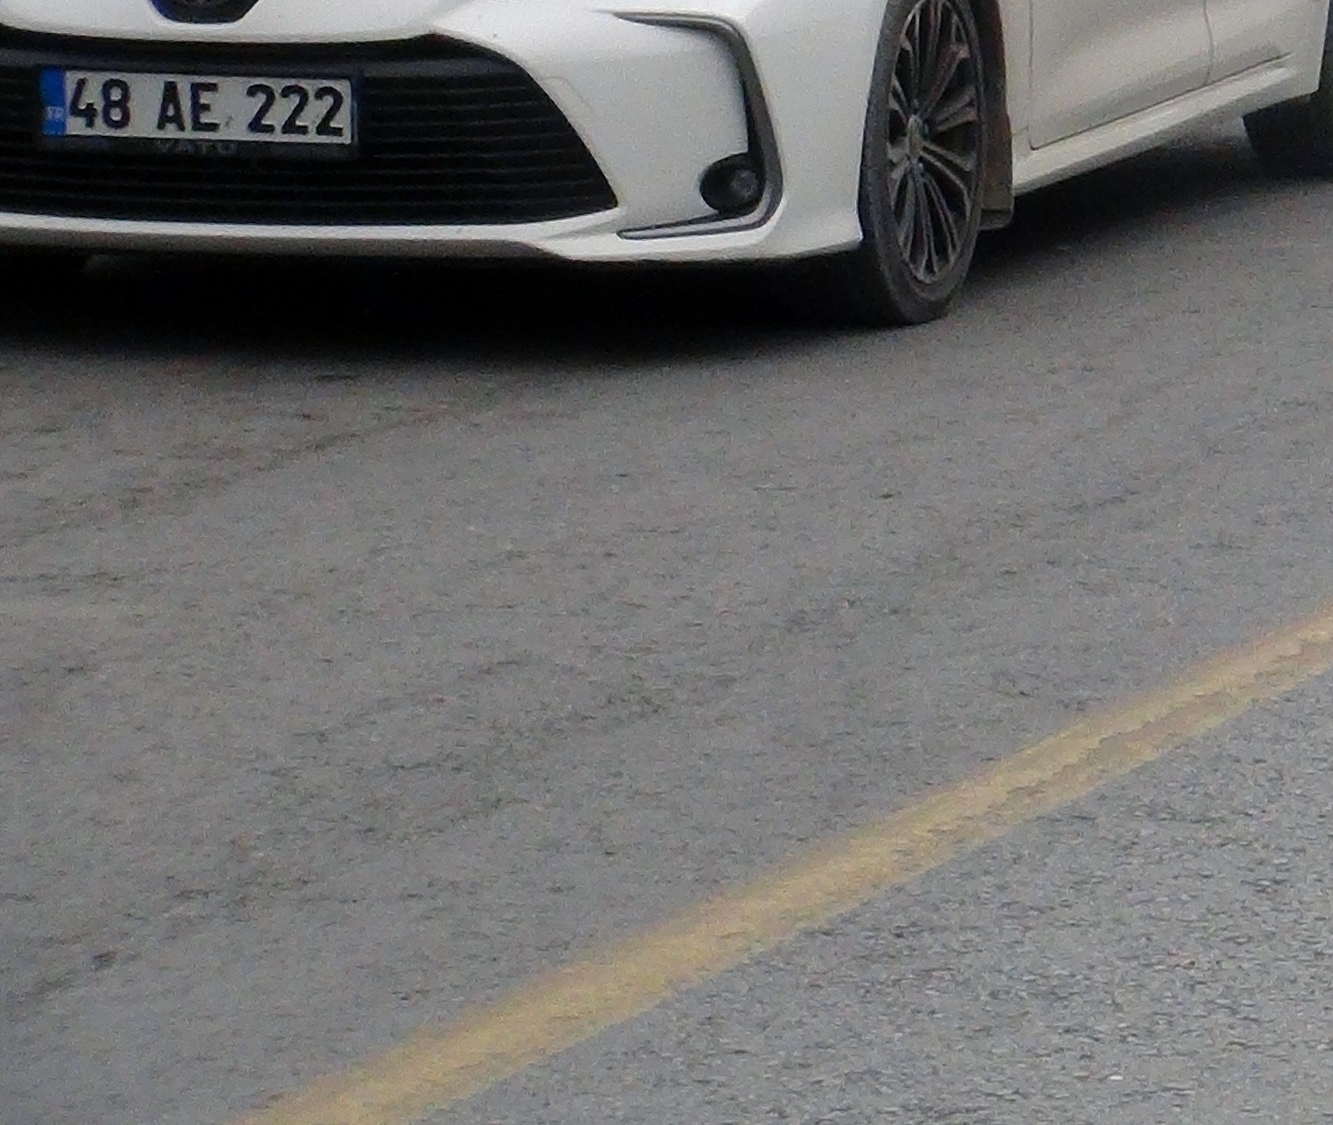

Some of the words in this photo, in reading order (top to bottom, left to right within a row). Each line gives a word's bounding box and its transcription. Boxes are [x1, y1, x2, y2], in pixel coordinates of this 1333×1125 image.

[68, 76, 131, 131] 48
[156, 79, 220, 133] AE
[245, 82, 345, 139] 222
